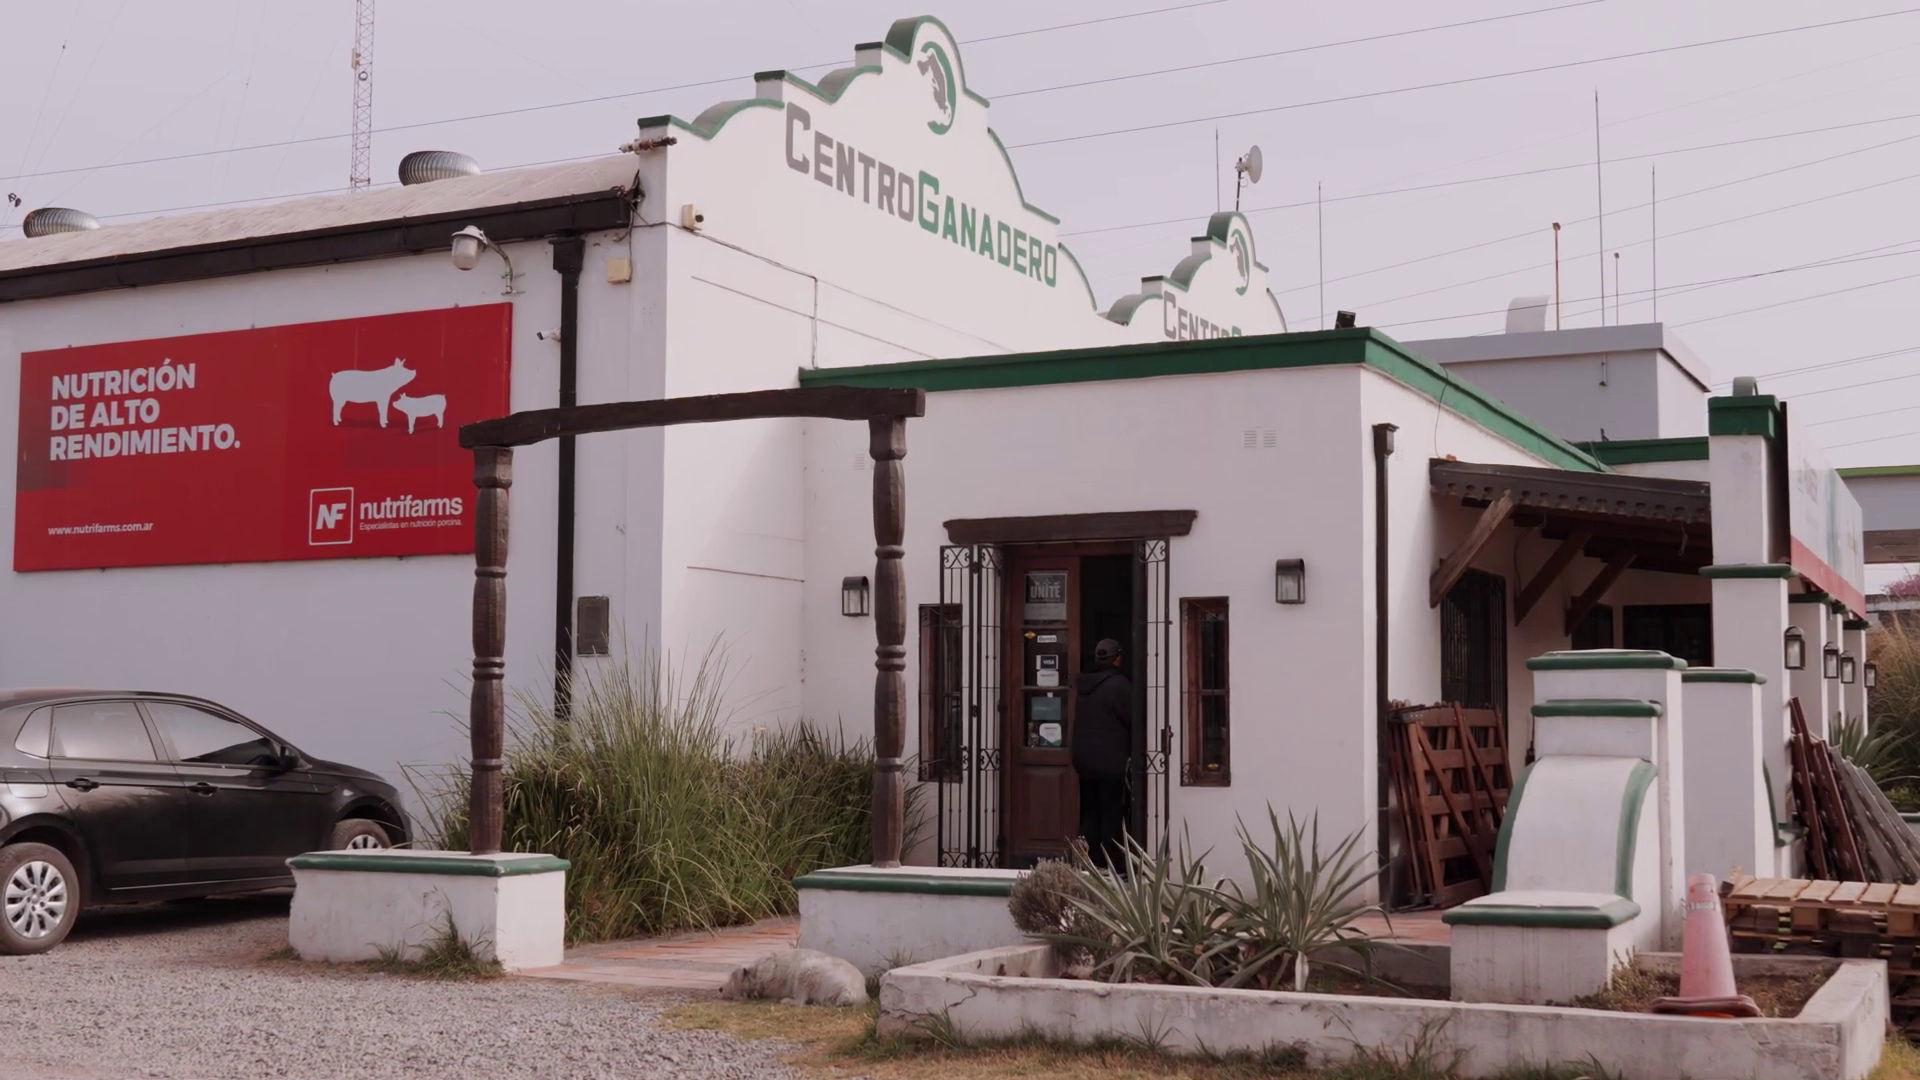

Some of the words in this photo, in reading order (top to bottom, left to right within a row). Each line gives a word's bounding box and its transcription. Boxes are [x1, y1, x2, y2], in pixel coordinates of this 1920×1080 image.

[51, 358, 196, 401] NUTRICIÓN
[50, 404, 86, 431] DE
[90, 398, 160, 428] ALTO
[49, 423, 241, 461] RENDIMIENTO.
[315, 503, 347, 530] NF
[360, 495, 463, 520] nutrifarms
[47, 522, 154, 535] www.nutrifarms.com.ar
[359, 521, 400, 531] Especialistas
[410, 518, 436, 528] nutrición
